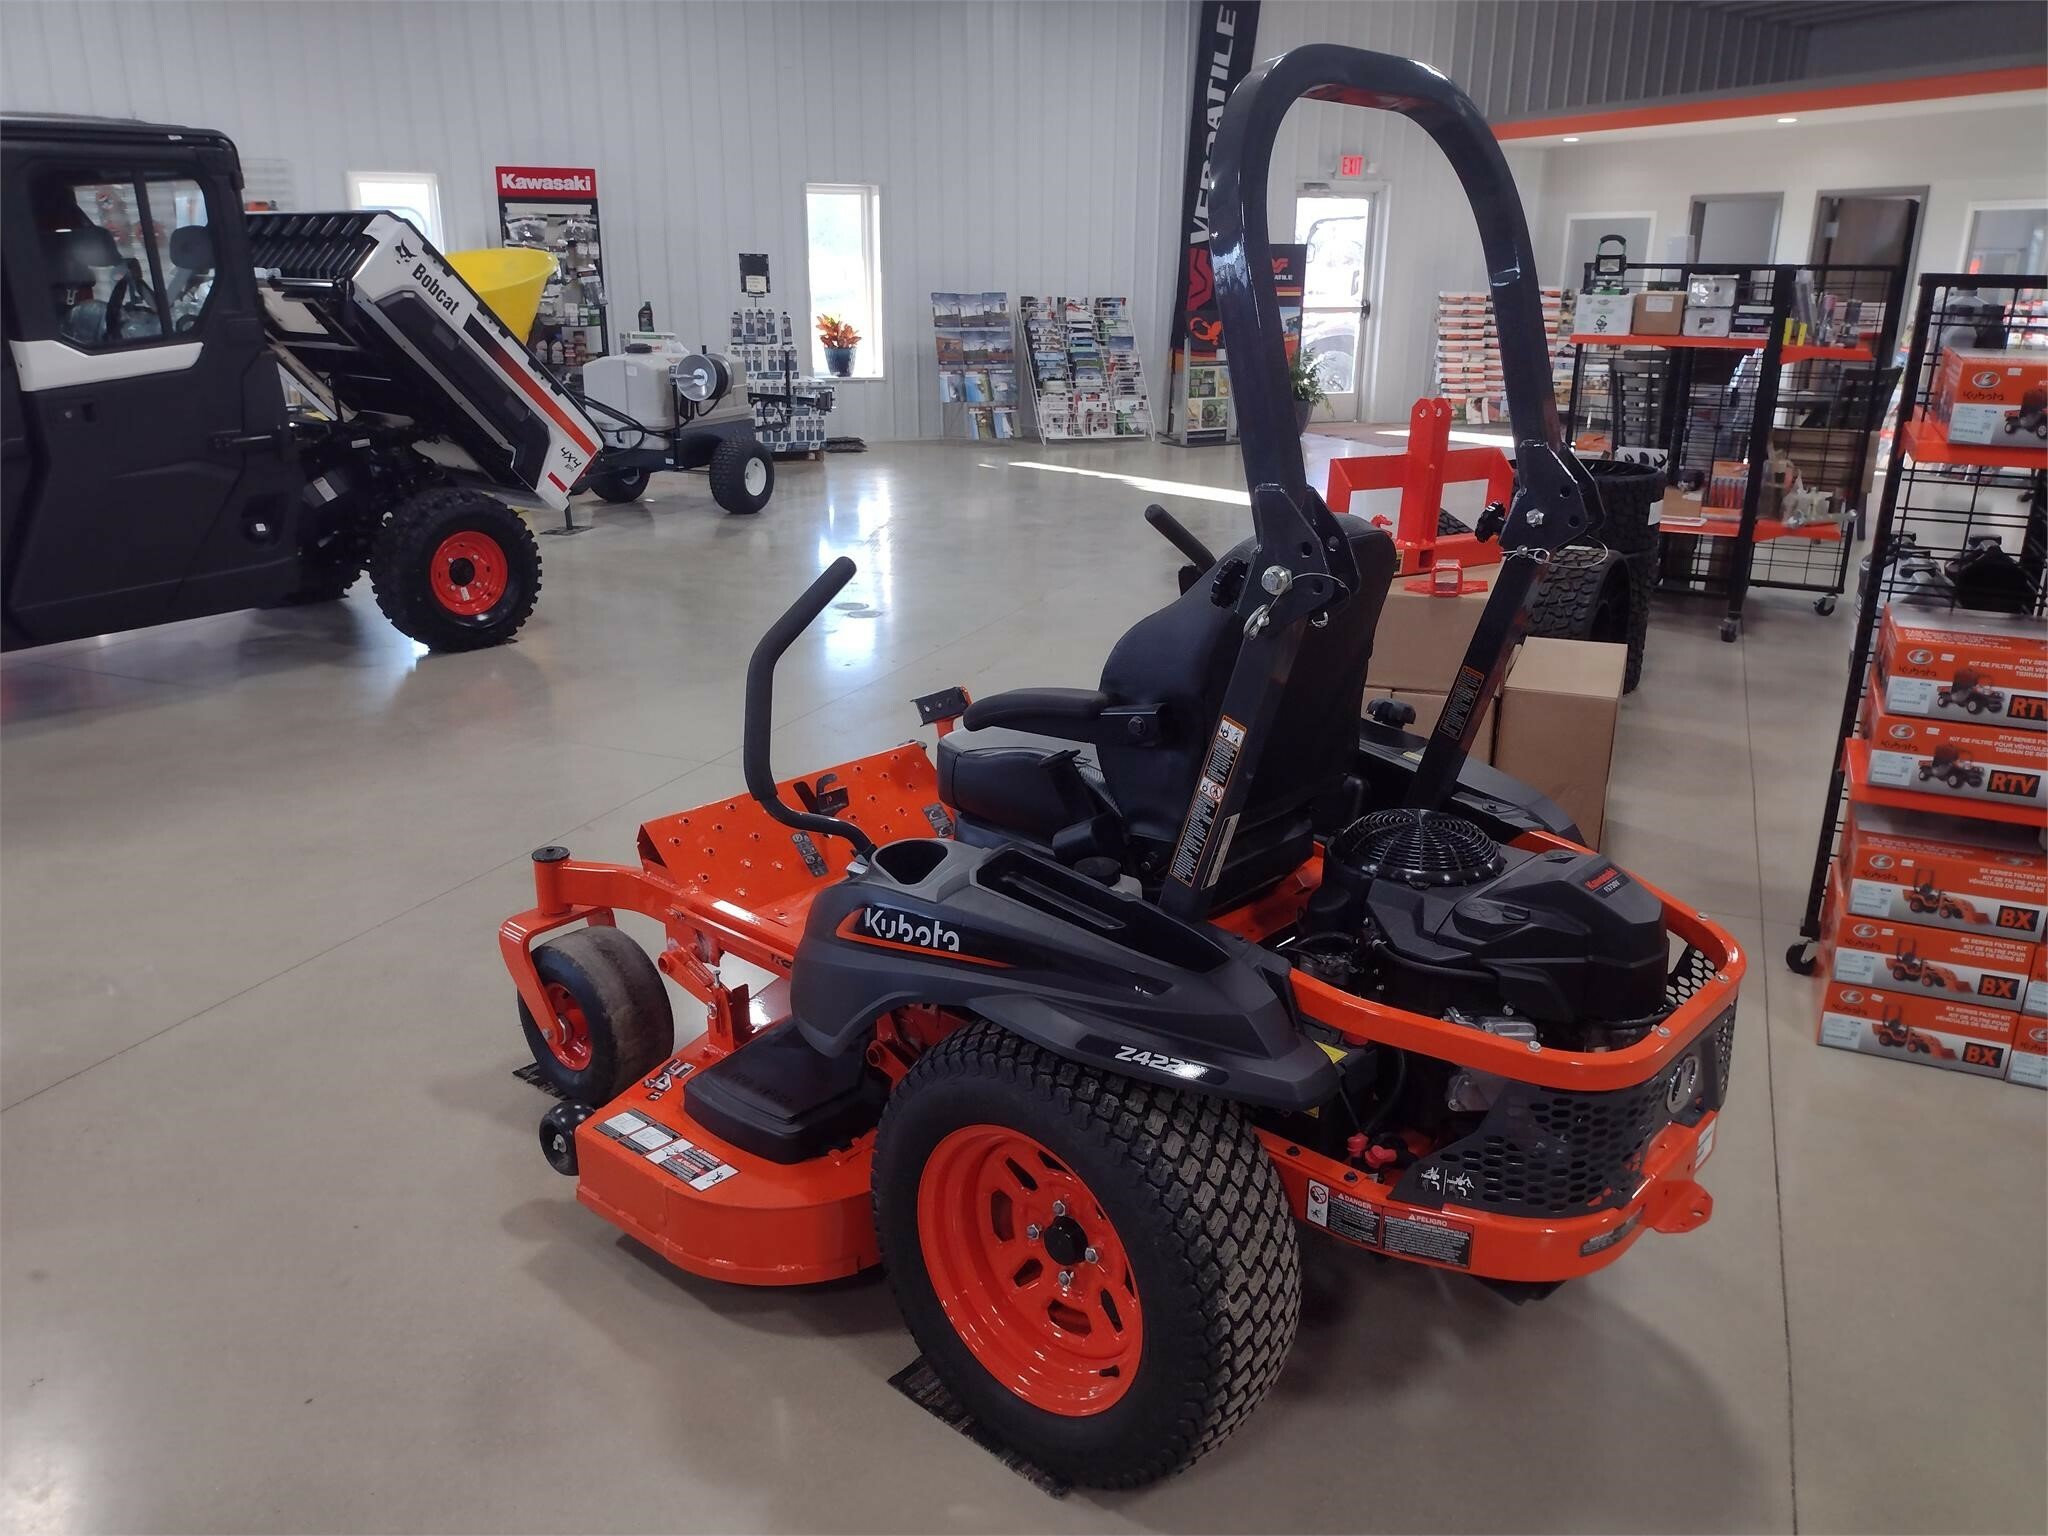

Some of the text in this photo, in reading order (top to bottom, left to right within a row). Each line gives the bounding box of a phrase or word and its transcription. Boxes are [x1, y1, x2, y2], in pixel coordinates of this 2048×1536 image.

[1342, 156, 1363, 176] EXIT
[501, 173, 591, 191] Kawasaki
[412, 262, 460, 315] Bobcat
[1963, 390, 2004, 401] Kubota
[1991, 772, 2037, 795] RTV
[865, 907, 960, 952] Kubota
[2001, 908, 2033, 930] BX
[1982, 977, 2013, 998] BX
[1966, 1045, 1996, 1066] BX
[1344, 1195, 1372, 1210] DANGER
[1416, 1215, 1448, 1227] PELIGRO
